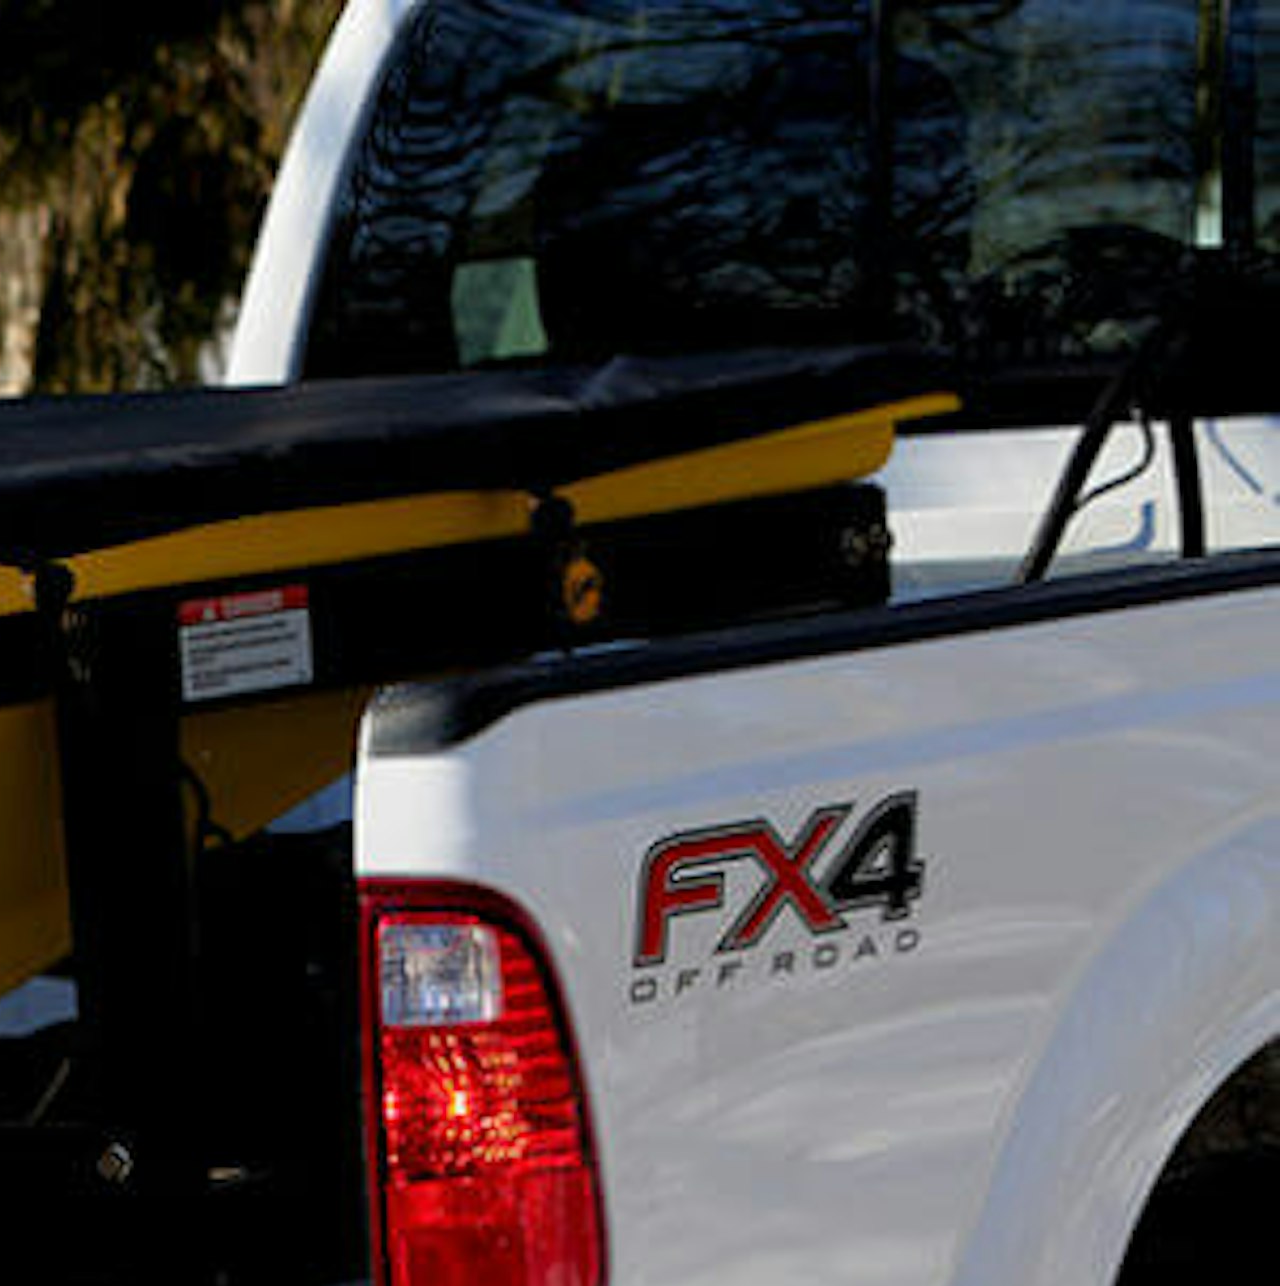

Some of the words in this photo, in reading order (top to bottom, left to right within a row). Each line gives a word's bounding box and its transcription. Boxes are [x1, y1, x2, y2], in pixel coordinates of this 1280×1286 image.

[632, 789, 926, 968] FX4
[630, 961, 742, 1004] OFF
[771, 928, 920, 974] ROAD
